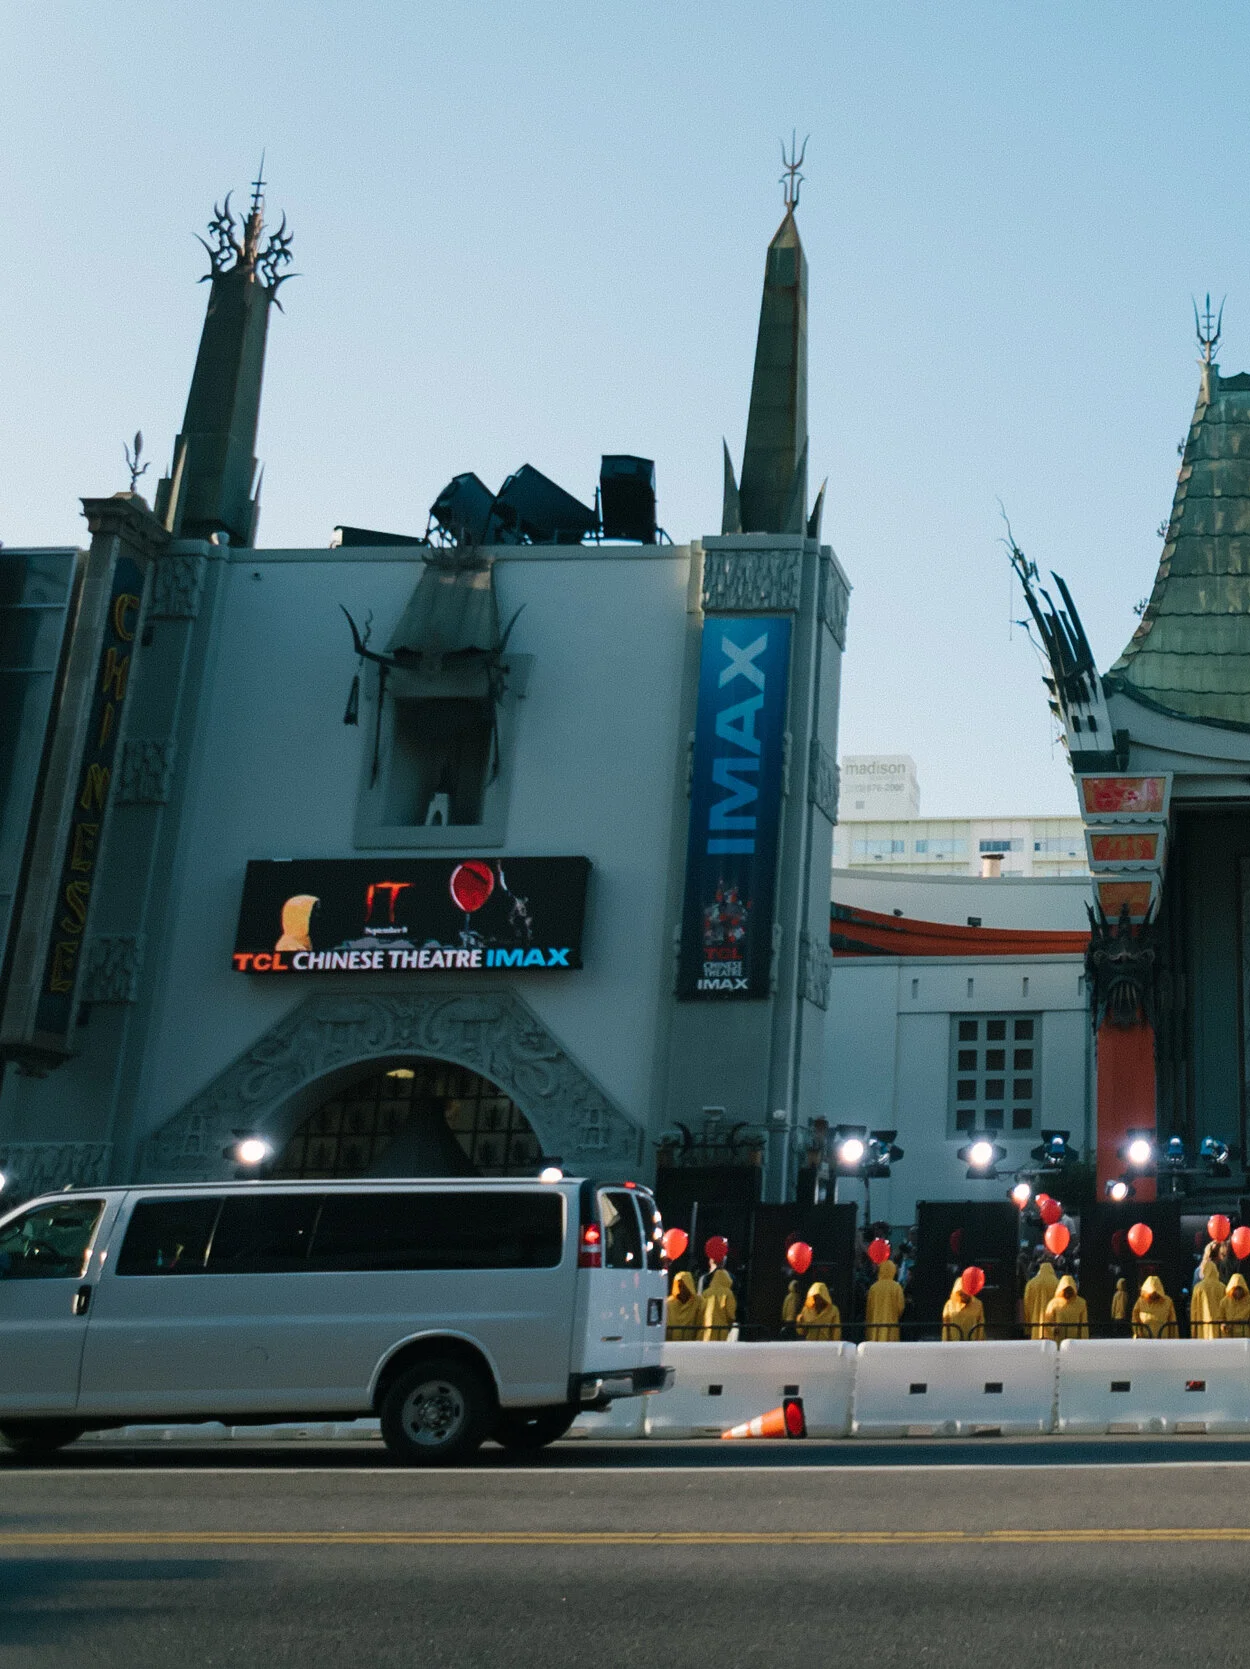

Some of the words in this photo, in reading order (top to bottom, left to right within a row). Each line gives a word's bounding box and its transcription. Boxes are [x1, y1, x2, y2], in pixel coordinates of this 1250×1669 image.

[707, 631, 769, 855] IMAX
[845, 761, 906, 775] madison
[50, 593, 140, 994] CHINESE
[364, 881, 415, 922] IT
[233, 953, 288, 971] TCL
[293, 951, 384, 970] CHINESE
[388, 949, 482, 968] THEATRE
[486, 947, 570, 967] IMAX
[703, 947, 744, 960] TCL
[697, 978, 749, 990] IMAX
